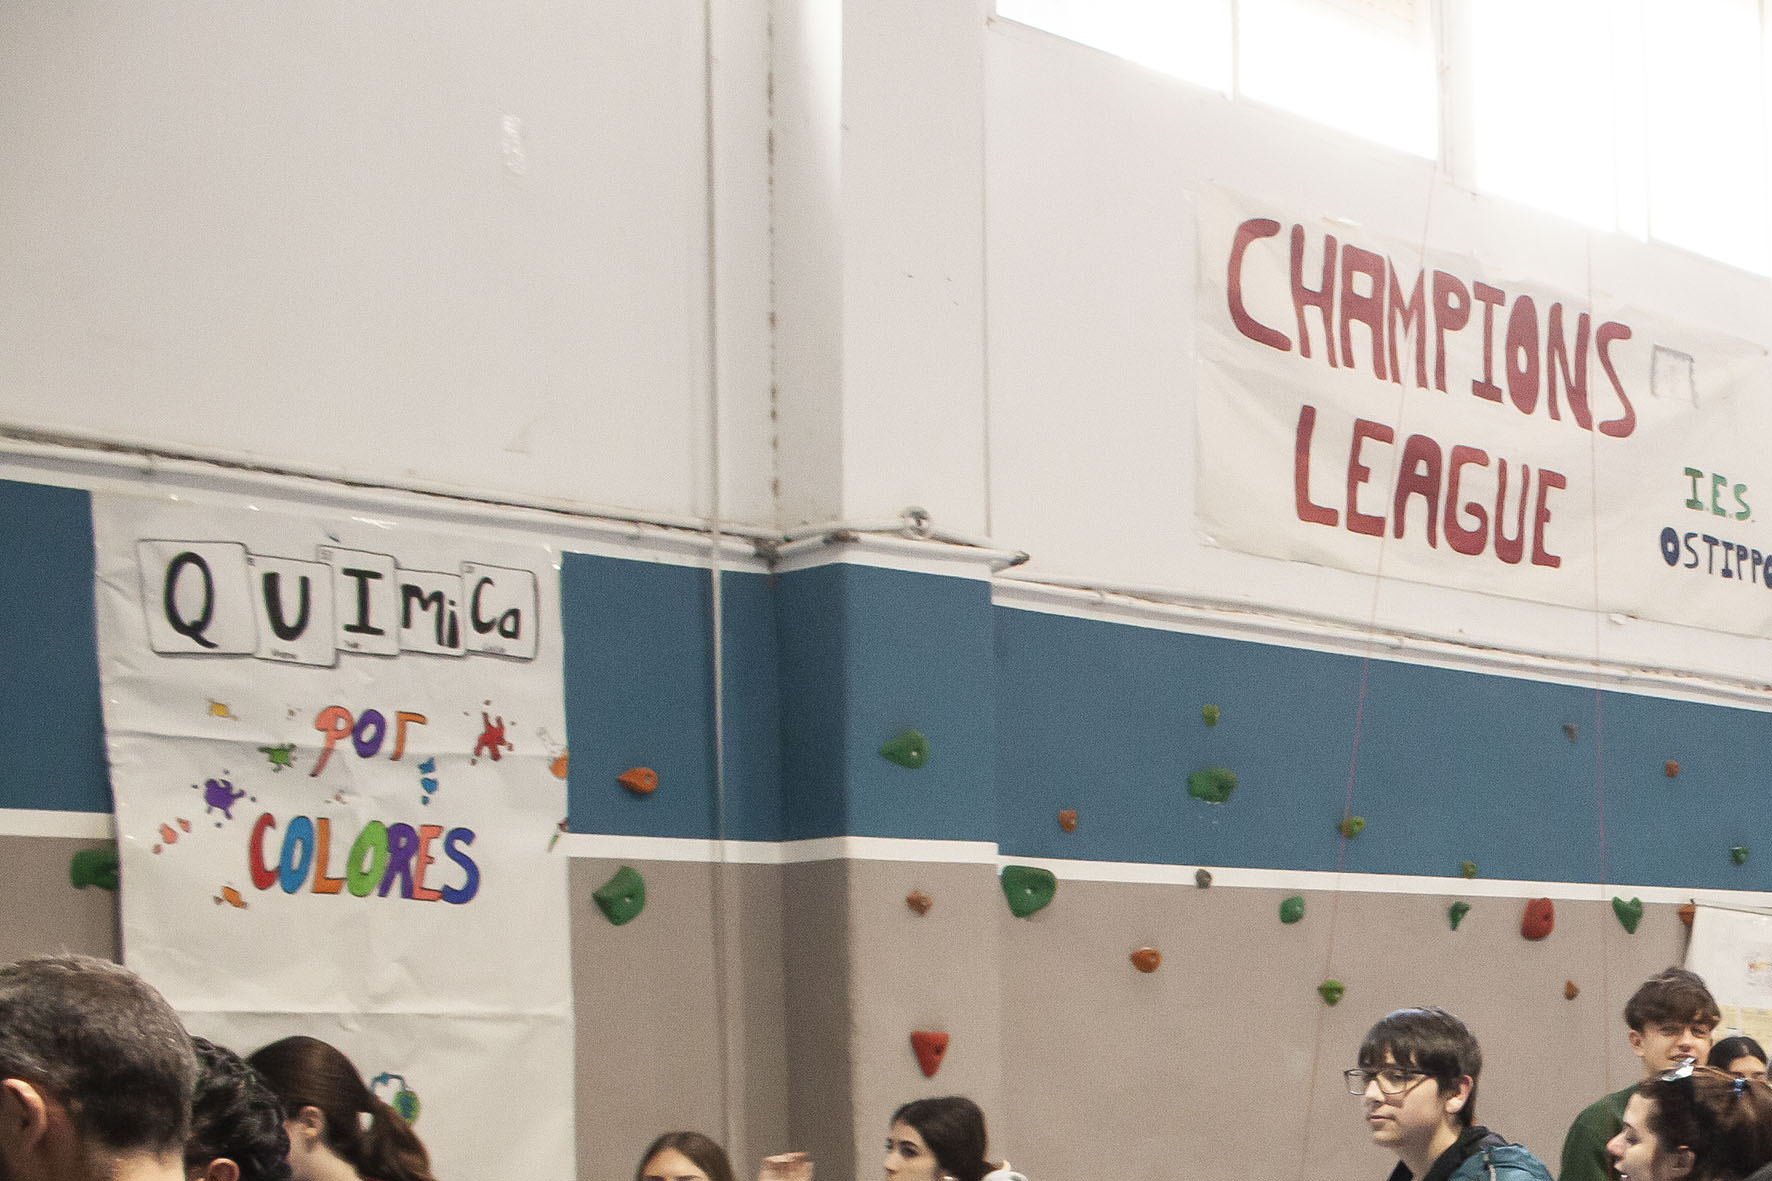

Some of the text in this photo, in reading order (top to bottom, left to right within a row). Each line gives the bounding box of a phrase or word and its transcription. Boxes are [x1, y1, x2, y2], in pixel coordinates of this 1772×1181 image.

[1227, 217, 1637, 439] CHAMPIONS
[1295, 404, 1567, 569] LEAGUE
[249, 812, 481, 904] COLORES
